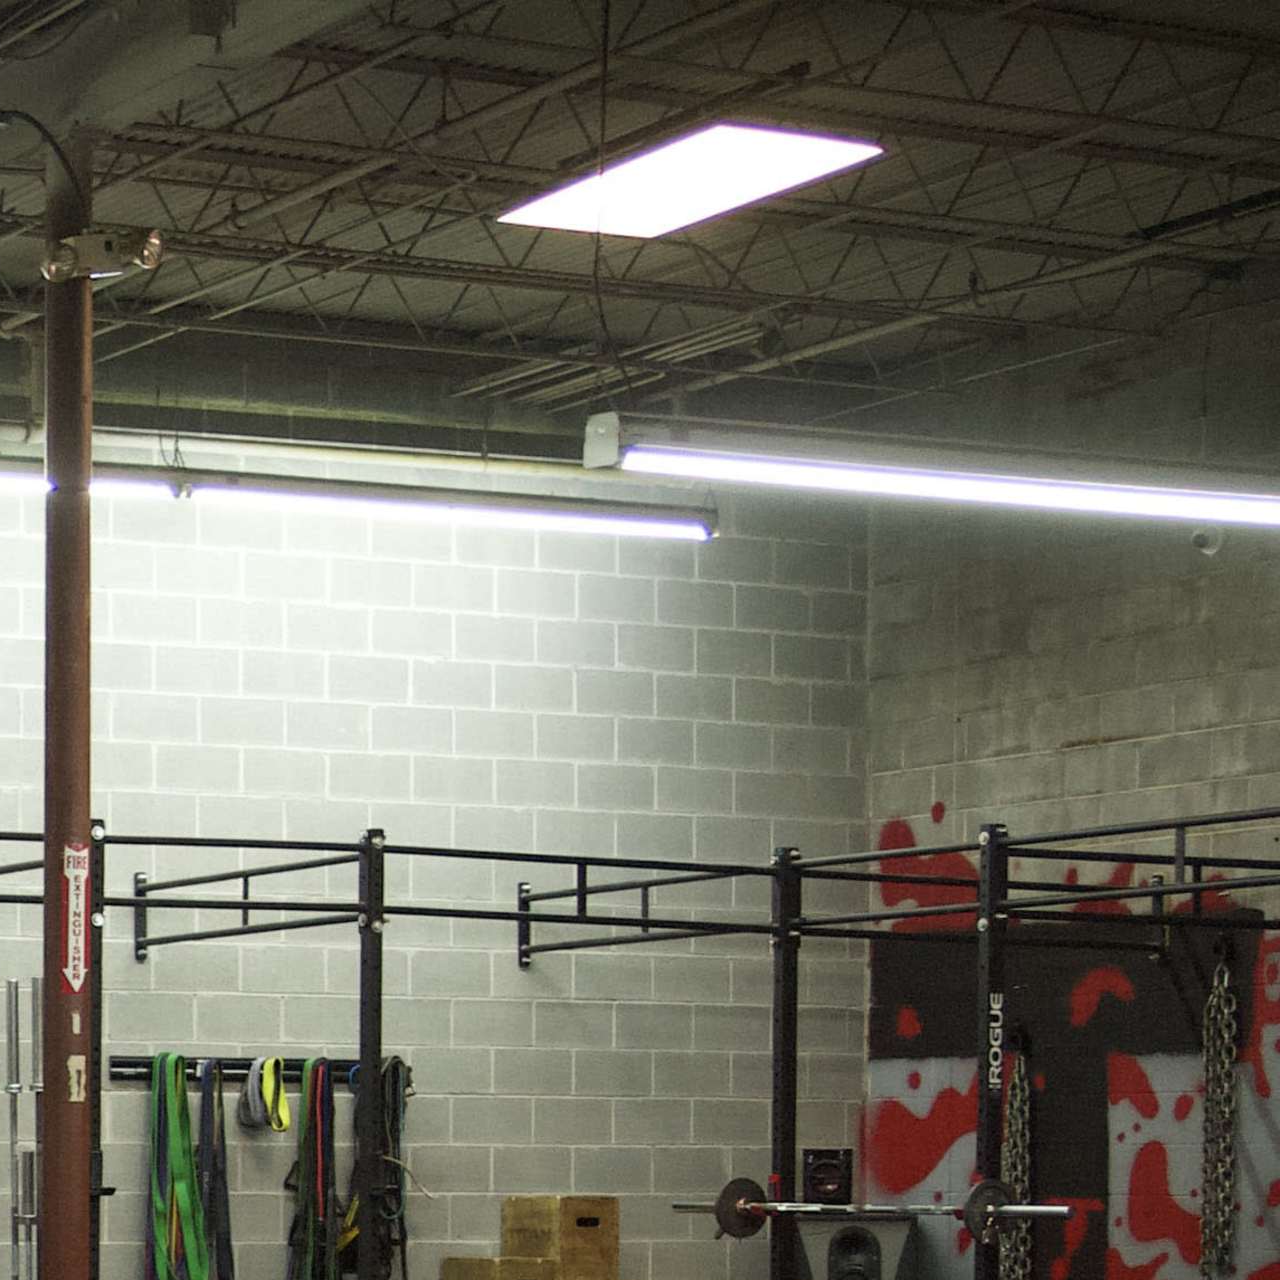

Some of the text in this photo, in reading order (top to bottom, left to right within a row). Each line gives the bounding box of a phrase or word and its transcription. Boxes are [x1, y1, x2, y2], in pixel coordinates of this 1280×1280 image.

[66, 855, 87, 869] FIRE
[72, 874, 82, 981] EXTINGUISHER
[988, 992, 1003, 1085] ROGUE
